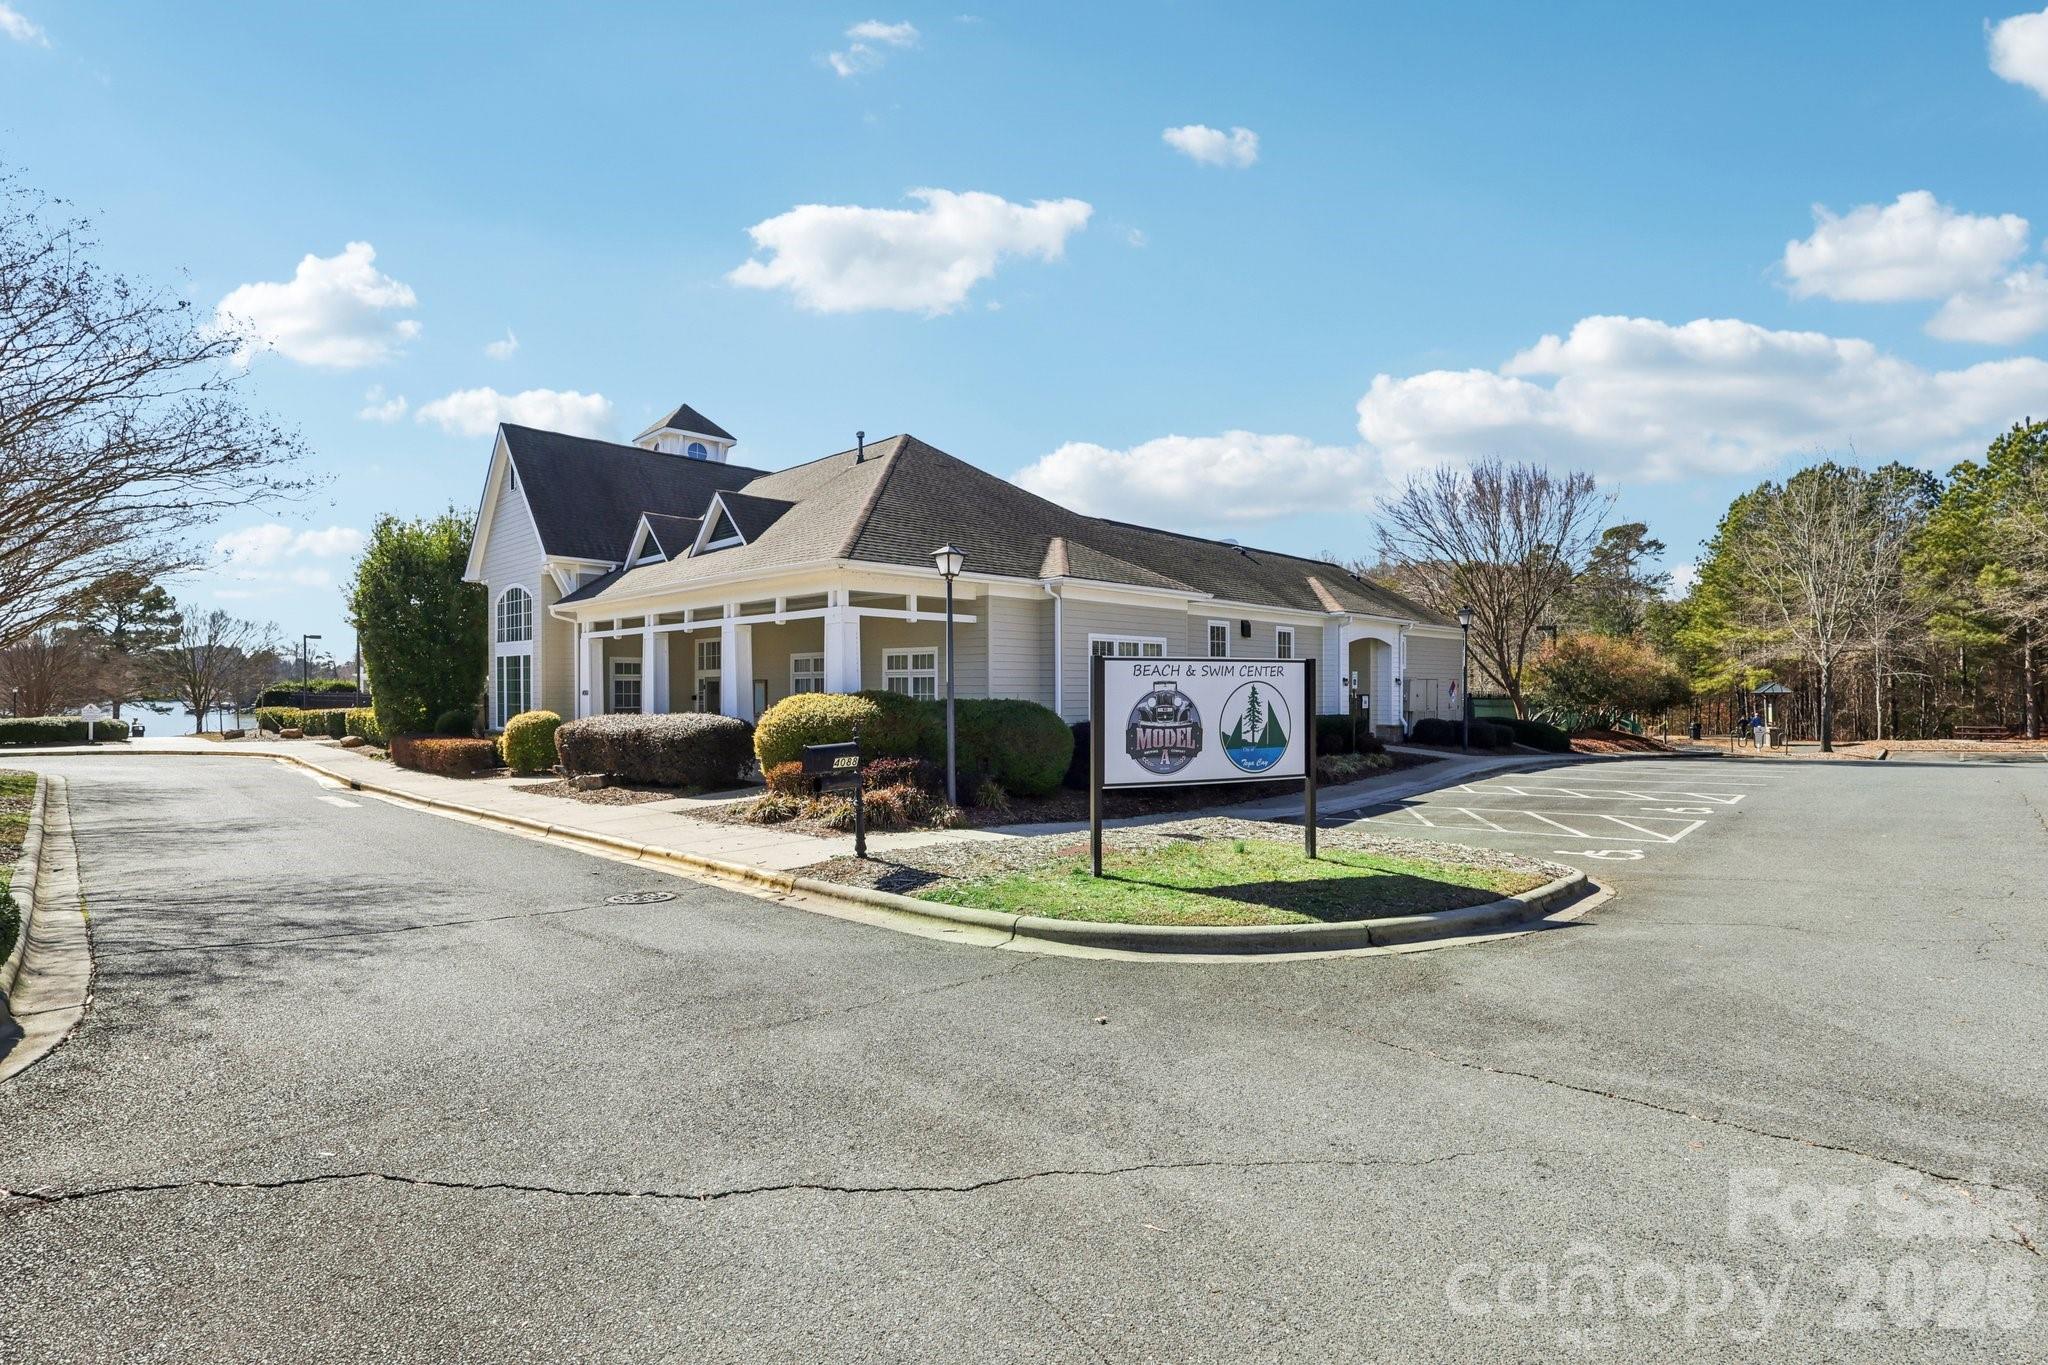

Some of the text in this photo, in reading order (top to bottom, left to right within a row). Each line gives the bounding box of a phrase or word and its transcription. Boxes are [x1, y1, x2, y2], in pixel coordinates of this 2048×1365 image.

[1133, 664, 1285, 677] BEACH & SWIM CENTER
[1136, 727, 1195, 750] MODEL
[835, 757, 858, 767] 4088
[1160, 749, 1170, 765] A
[1256, 758, 1268, 767] Cay
